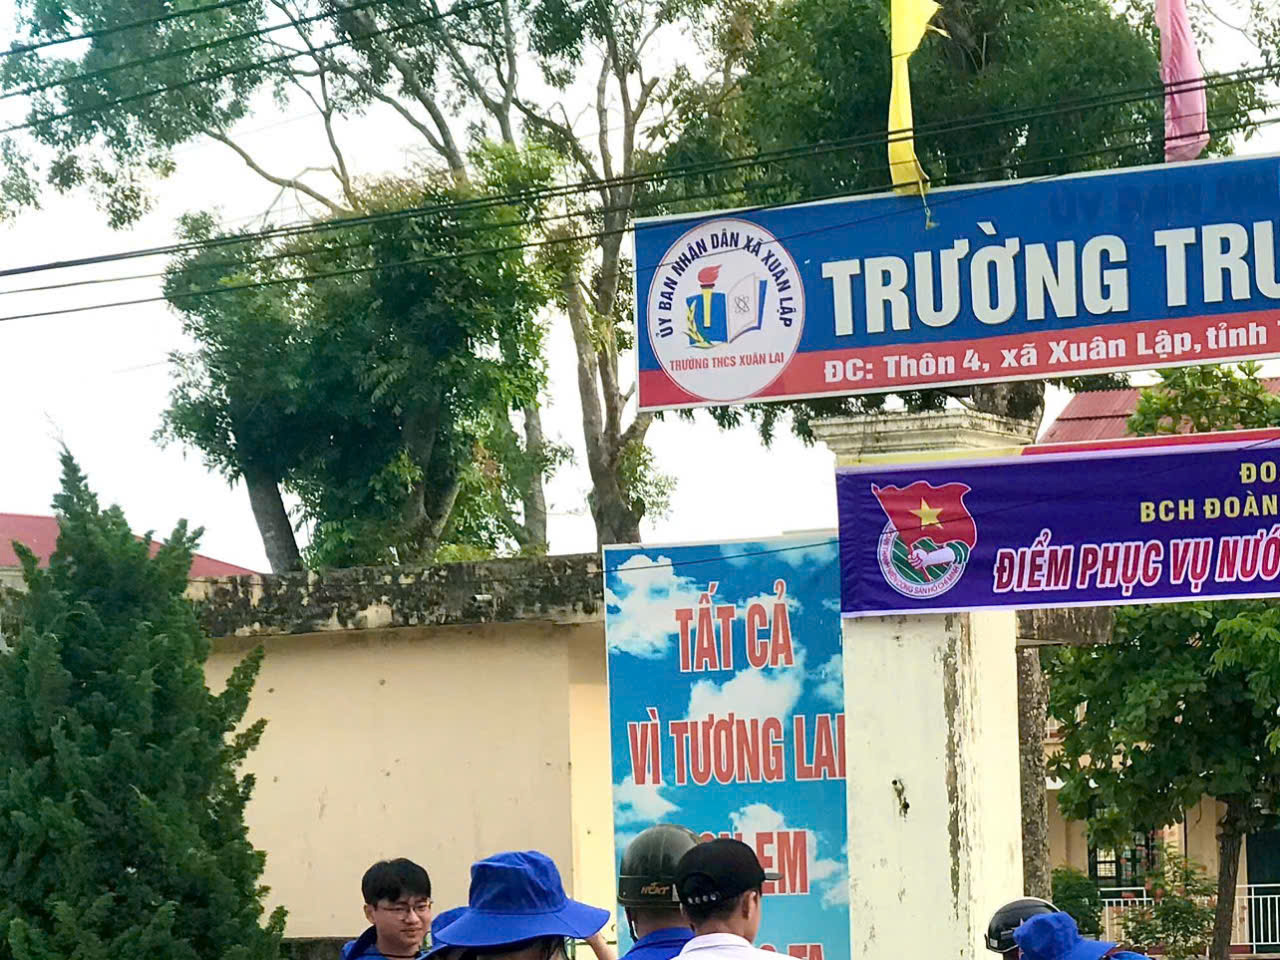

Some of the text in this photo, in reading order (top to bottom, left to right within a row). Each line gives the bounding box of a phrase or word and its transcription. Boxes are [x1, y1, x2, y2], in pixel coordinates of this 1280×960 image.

[656, 228, 796, 338] ỦY BAN NHÂN DÂN XÃ XUÂN LẬP
[821, 221, 1130, 337] TRƯỜNG
[711, 355, 736, 368] THCS
[739, 352, 766, 366] XUÂN
[769, 352, 784, 364] LAI
[823, 358, 873, 384] ĐC:
[883, 350, 956, 378] Thôn
[962, 349, 990, 374] 4,
[1000, 342, 1038, 368] xã
[1048, 334, 1126, 364] Xuân
[1139, 498, 1196, 523] BCH
[1203, 489, 1279, 519] ĐOÀN
[993, 528, 1074, 593] ĐIỂM
[1078, 536, 1163, 597] PHỤC
[1169, 538, 1213, 592] VỤ
[674, 578, 795, 673] TẤT CẢ
[627, 707, 846, 786] VÌ TƯƠNG LAI
[755, 830, 810, 895] EM
